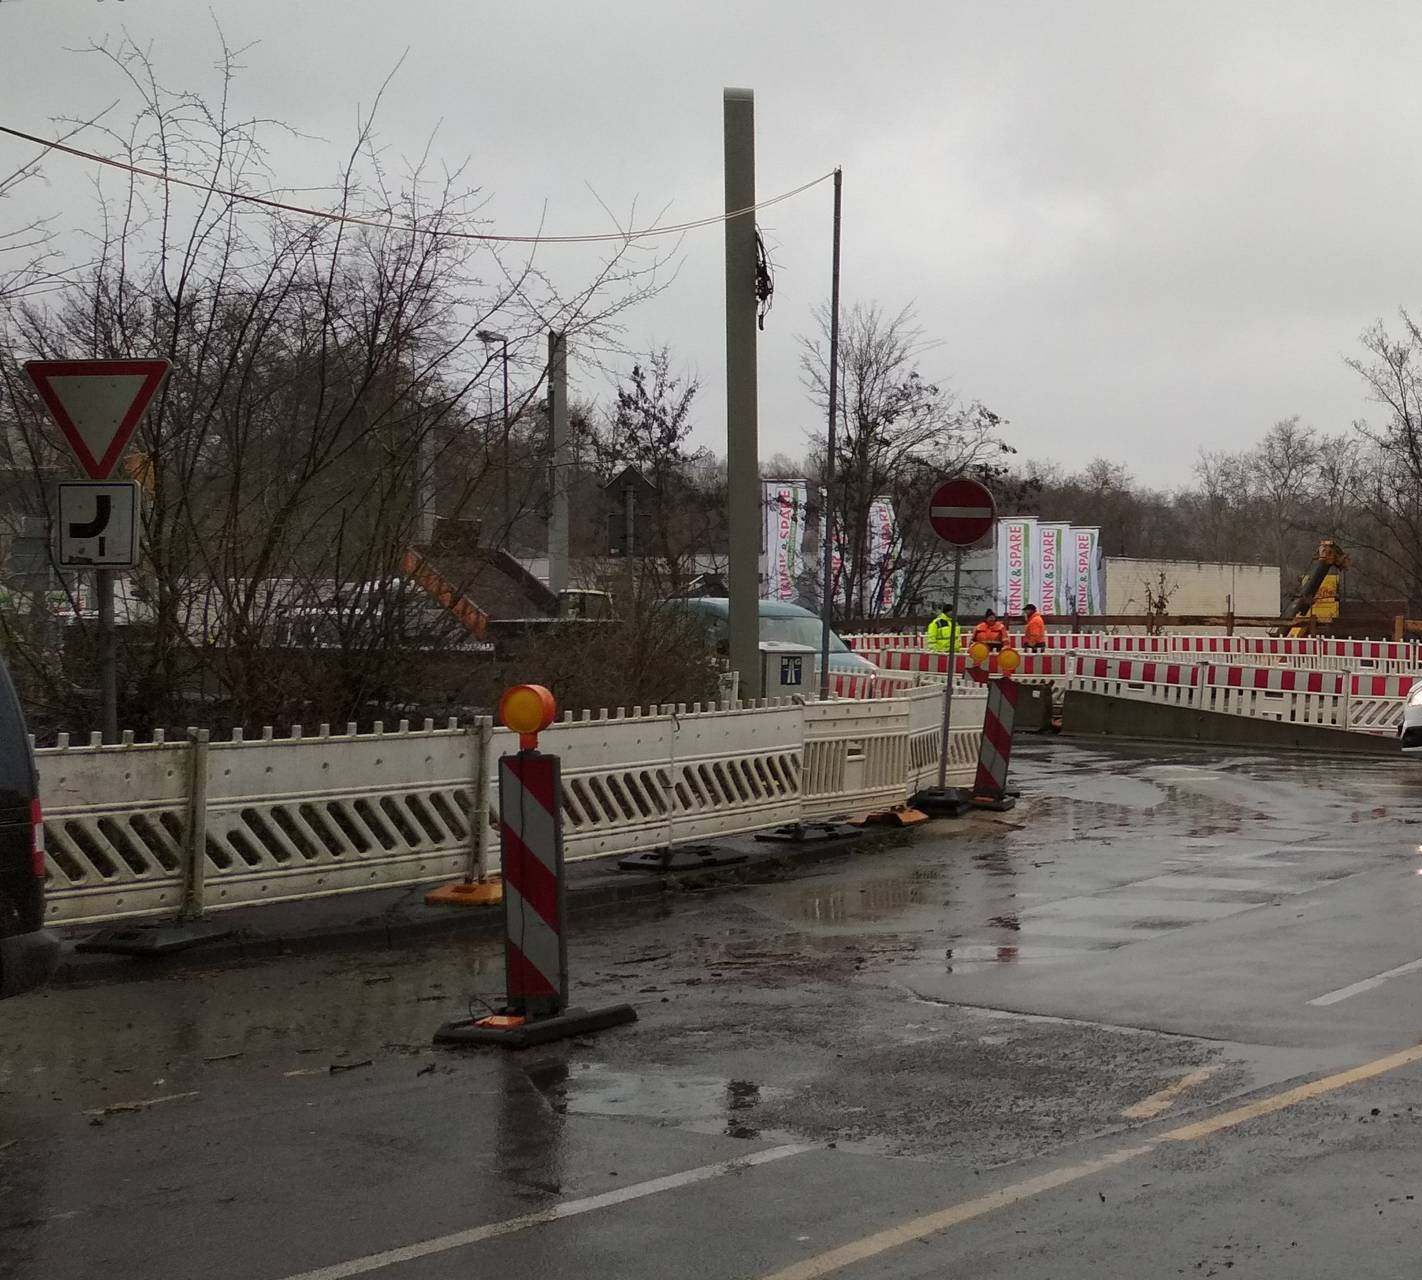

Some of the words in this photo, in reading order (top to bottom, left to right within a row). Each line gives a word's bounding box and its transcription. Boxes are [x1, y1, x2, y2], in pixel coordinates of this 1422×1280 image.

[1010, 527, 1021, 567] SPARE
[1043, 532, 1055, 569] SPARE
[1078, 536, 1089, 573] SPARE
[1078, 585, 1088, 615] RINK
